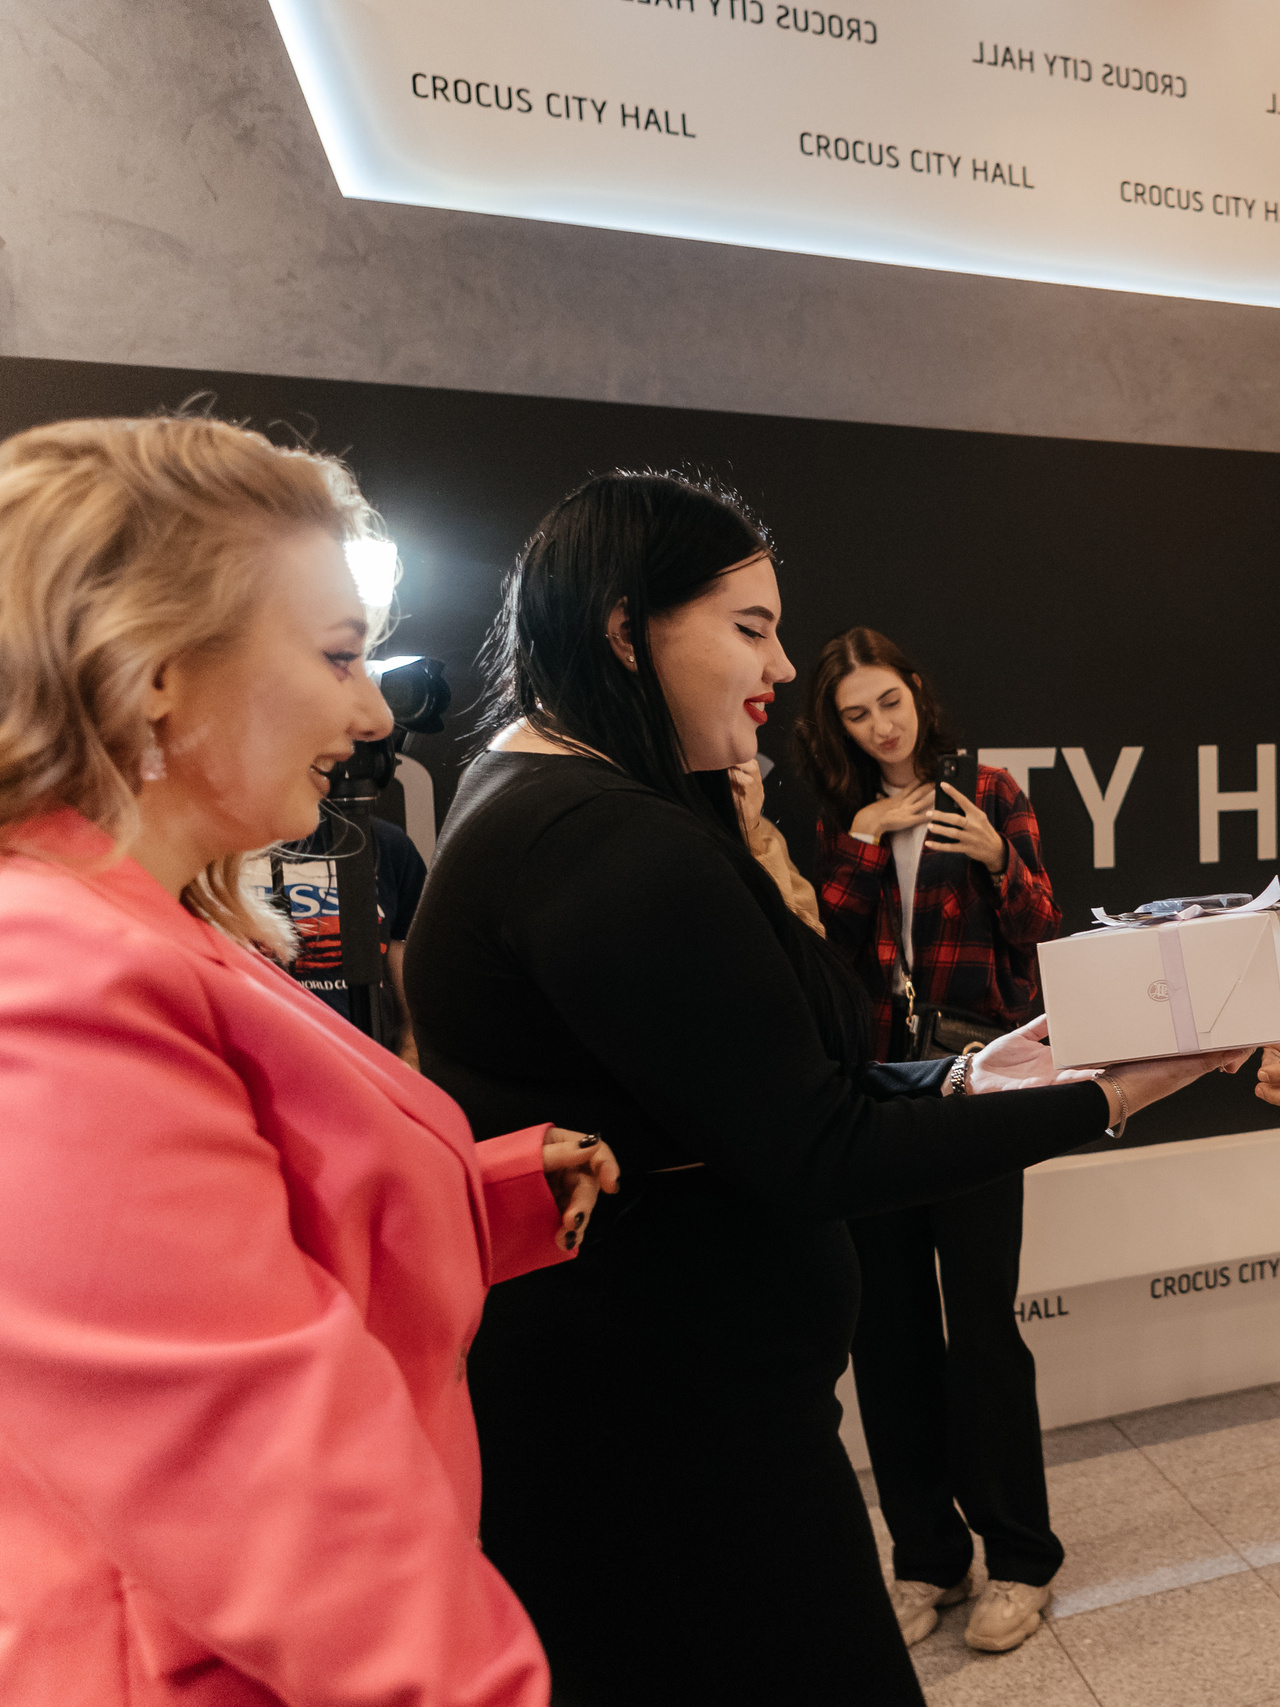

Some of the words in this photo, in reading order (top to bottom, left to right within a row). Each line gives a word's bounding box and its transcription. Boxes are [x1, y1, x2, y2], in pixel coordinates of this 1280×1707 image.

[411, 72, 533, 114] CROCUS
[545, 92, 607, 124] CITY
[620, 103, 696, 139] HALL
[799, 131, 900, 169] CROCUS
[910, 148, 962, 178] CITY
[971, 158, 1035, 190] HALL
[1119, 180, 1205, 213] CROCUS
[1212, 193, 1256, 219] CITY
[957, 746, 1145, 869] TY
[1149, 1265, 1233, 1300] CROCUS
